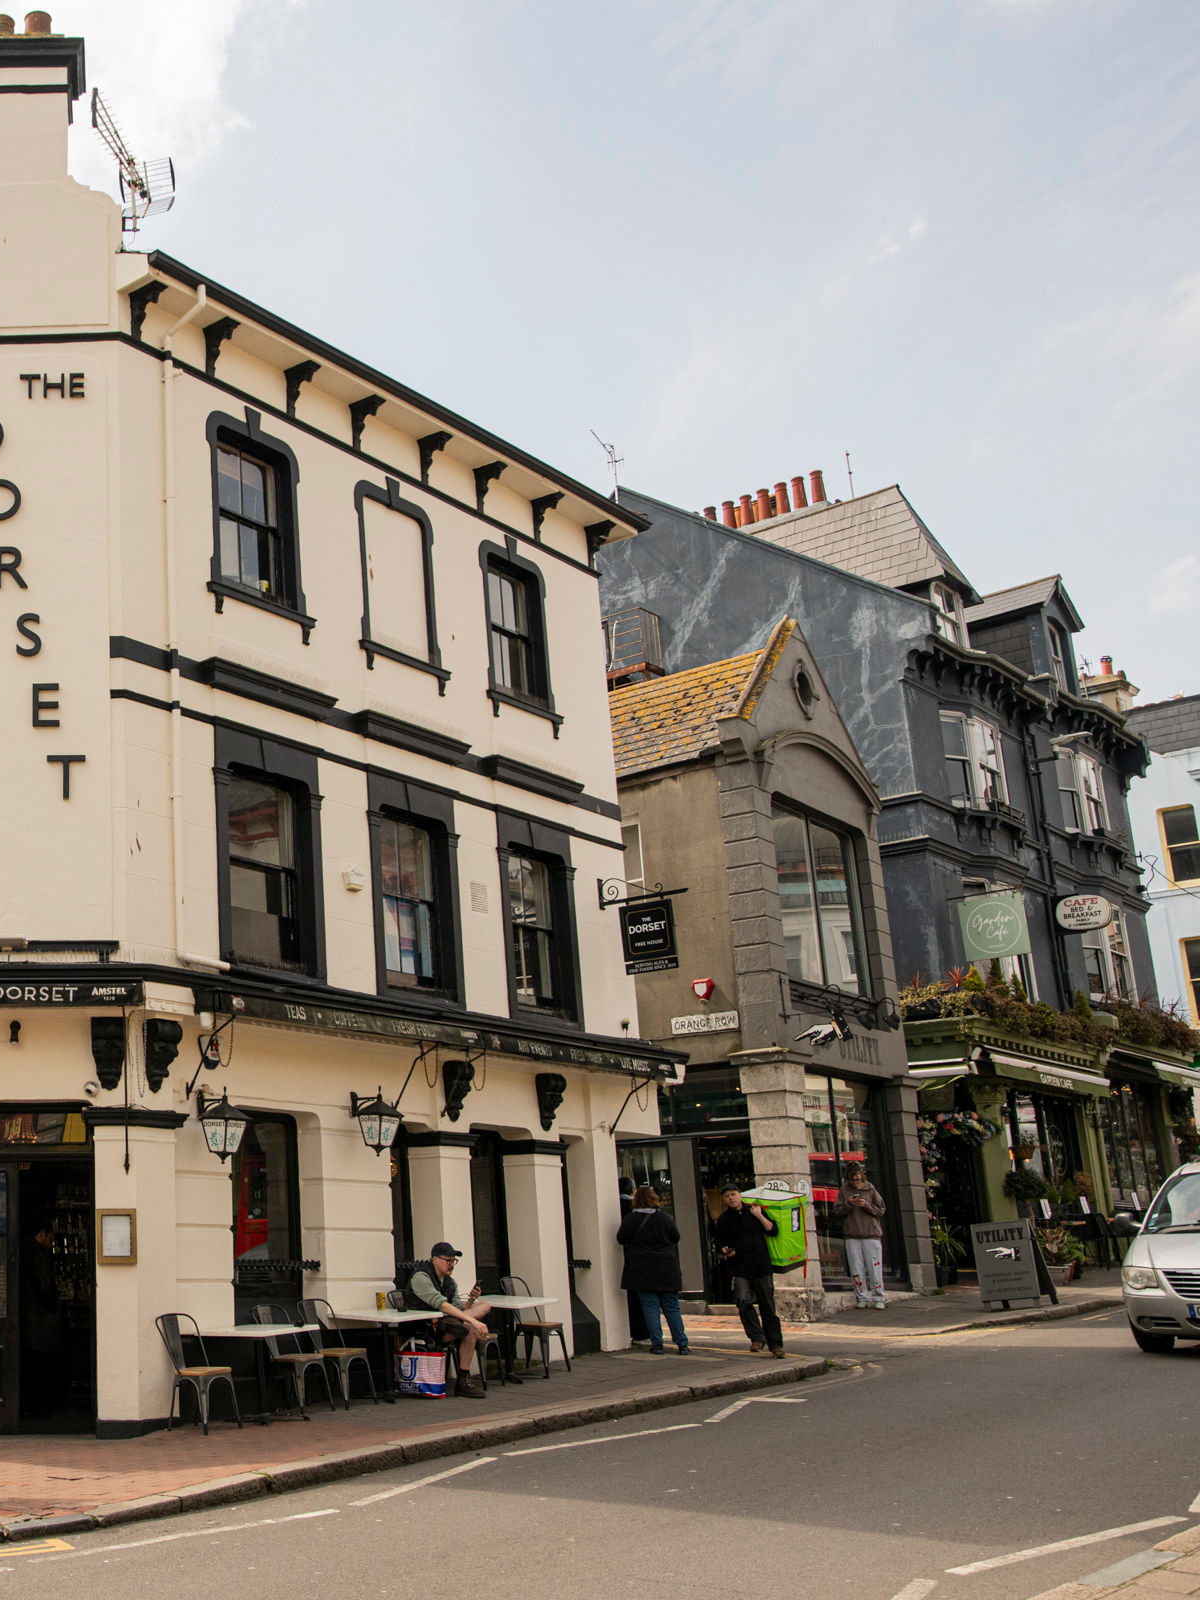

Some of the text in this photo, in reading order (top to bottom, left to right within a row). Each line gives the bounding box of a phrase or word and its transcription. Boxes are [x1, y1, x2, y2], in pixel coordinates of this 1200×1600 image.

[20, 373, 85, 399] THE
[1063, 897, 1098, 907] CAFE
[1063, 911, 1102, 920] BREAKFAST
[628, 921, 666, 934] DORSET
[91, 986, 127, 996] AMSTEL
[284, 1004, 307, 1020] TEAS
[674, 1015, 736, 1031] ORANGE ROW
[1040, 1073, 1074, 1090] GARDEN CAFE
[227, 1121, 246, 1129] DORSET
[975, 1227, 1024, 1244] UTILITY
[397, 1356, 419, 1382] U
